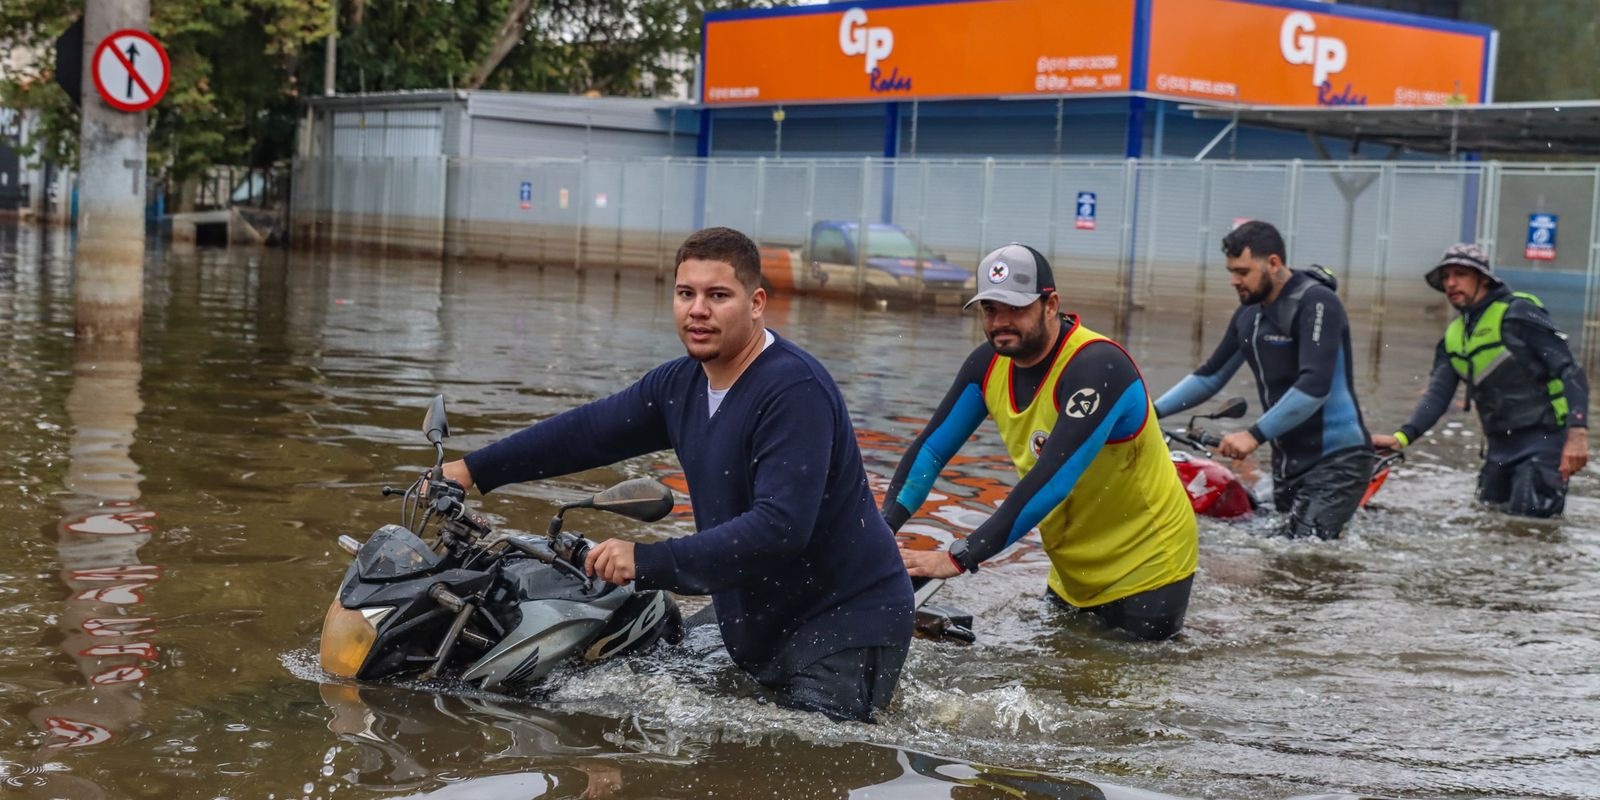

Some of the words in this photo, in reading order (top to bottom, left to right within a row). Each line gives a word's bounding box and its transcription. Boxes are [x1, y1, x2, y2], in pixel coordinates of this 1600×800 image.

[839, 7, 894, 74] GP
[1280, 10, 1348, 87] GP
[870, 66, 912, 93] Rodas
